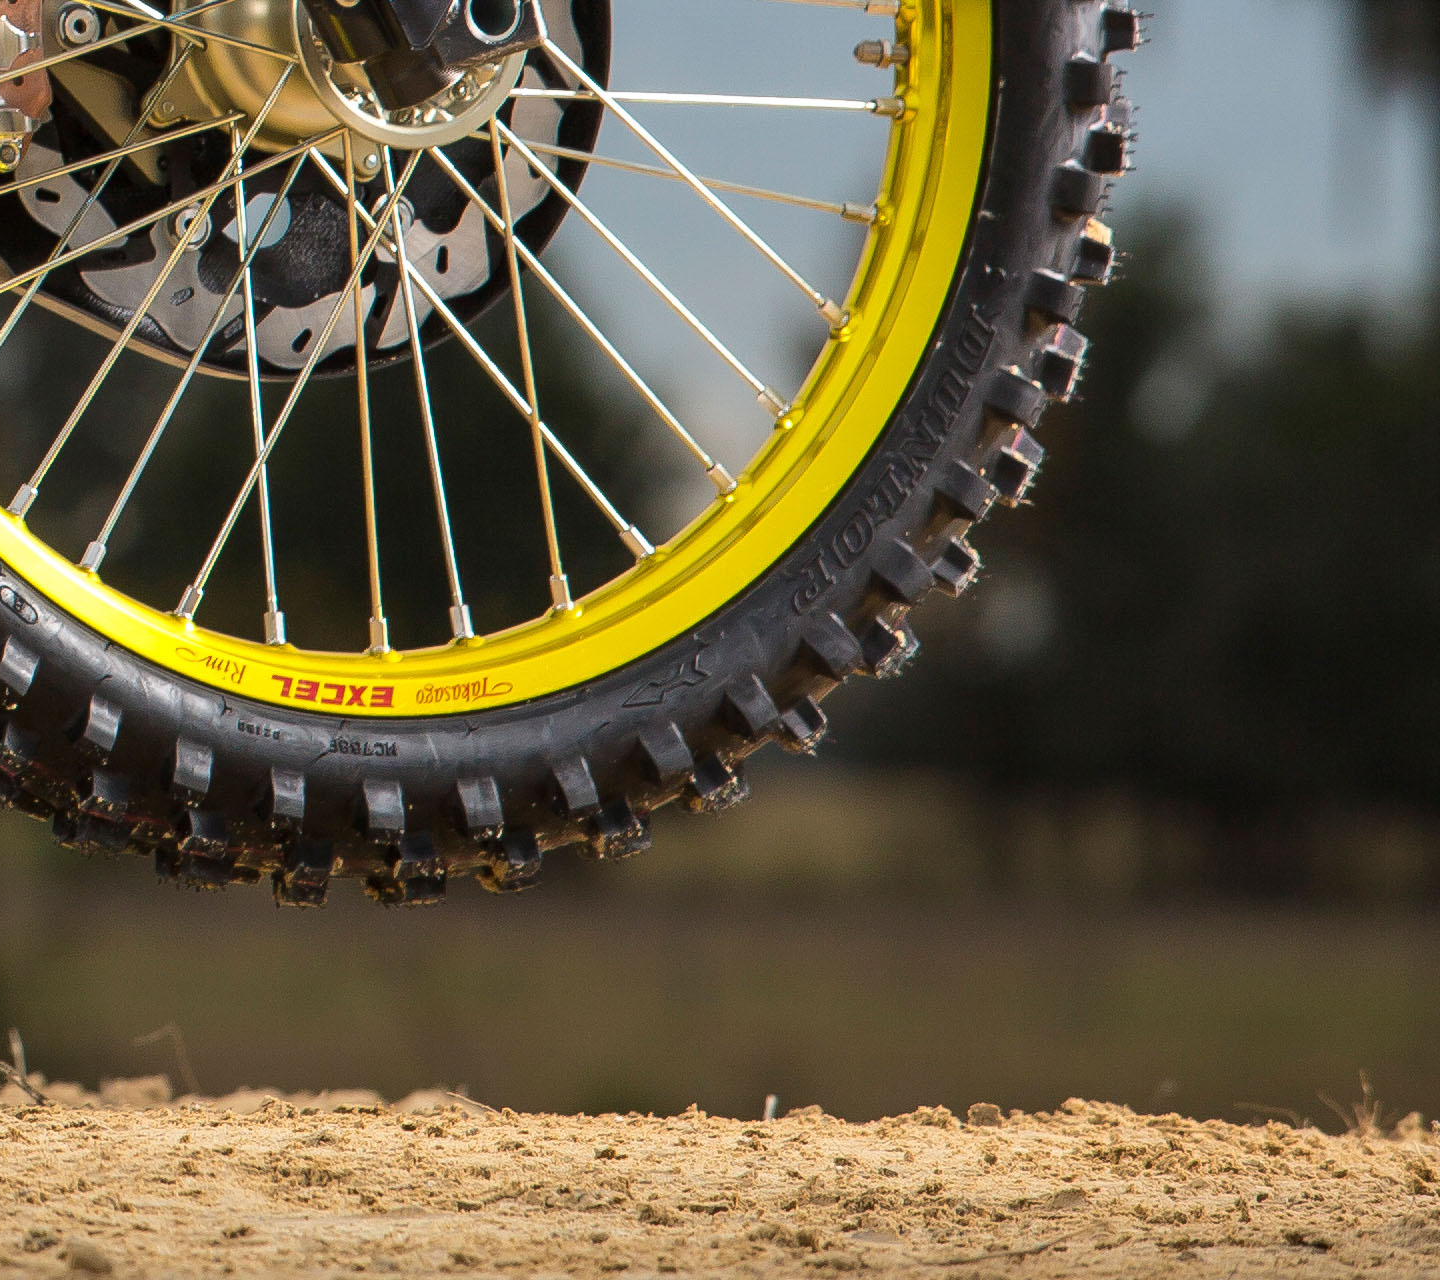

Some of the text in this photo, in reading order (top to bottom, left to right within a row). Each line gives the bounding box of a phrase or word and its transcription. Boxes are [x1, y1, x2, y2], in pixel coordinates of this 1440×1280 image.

[175, 646, 513, 708] Takasago EXCEL Rim
